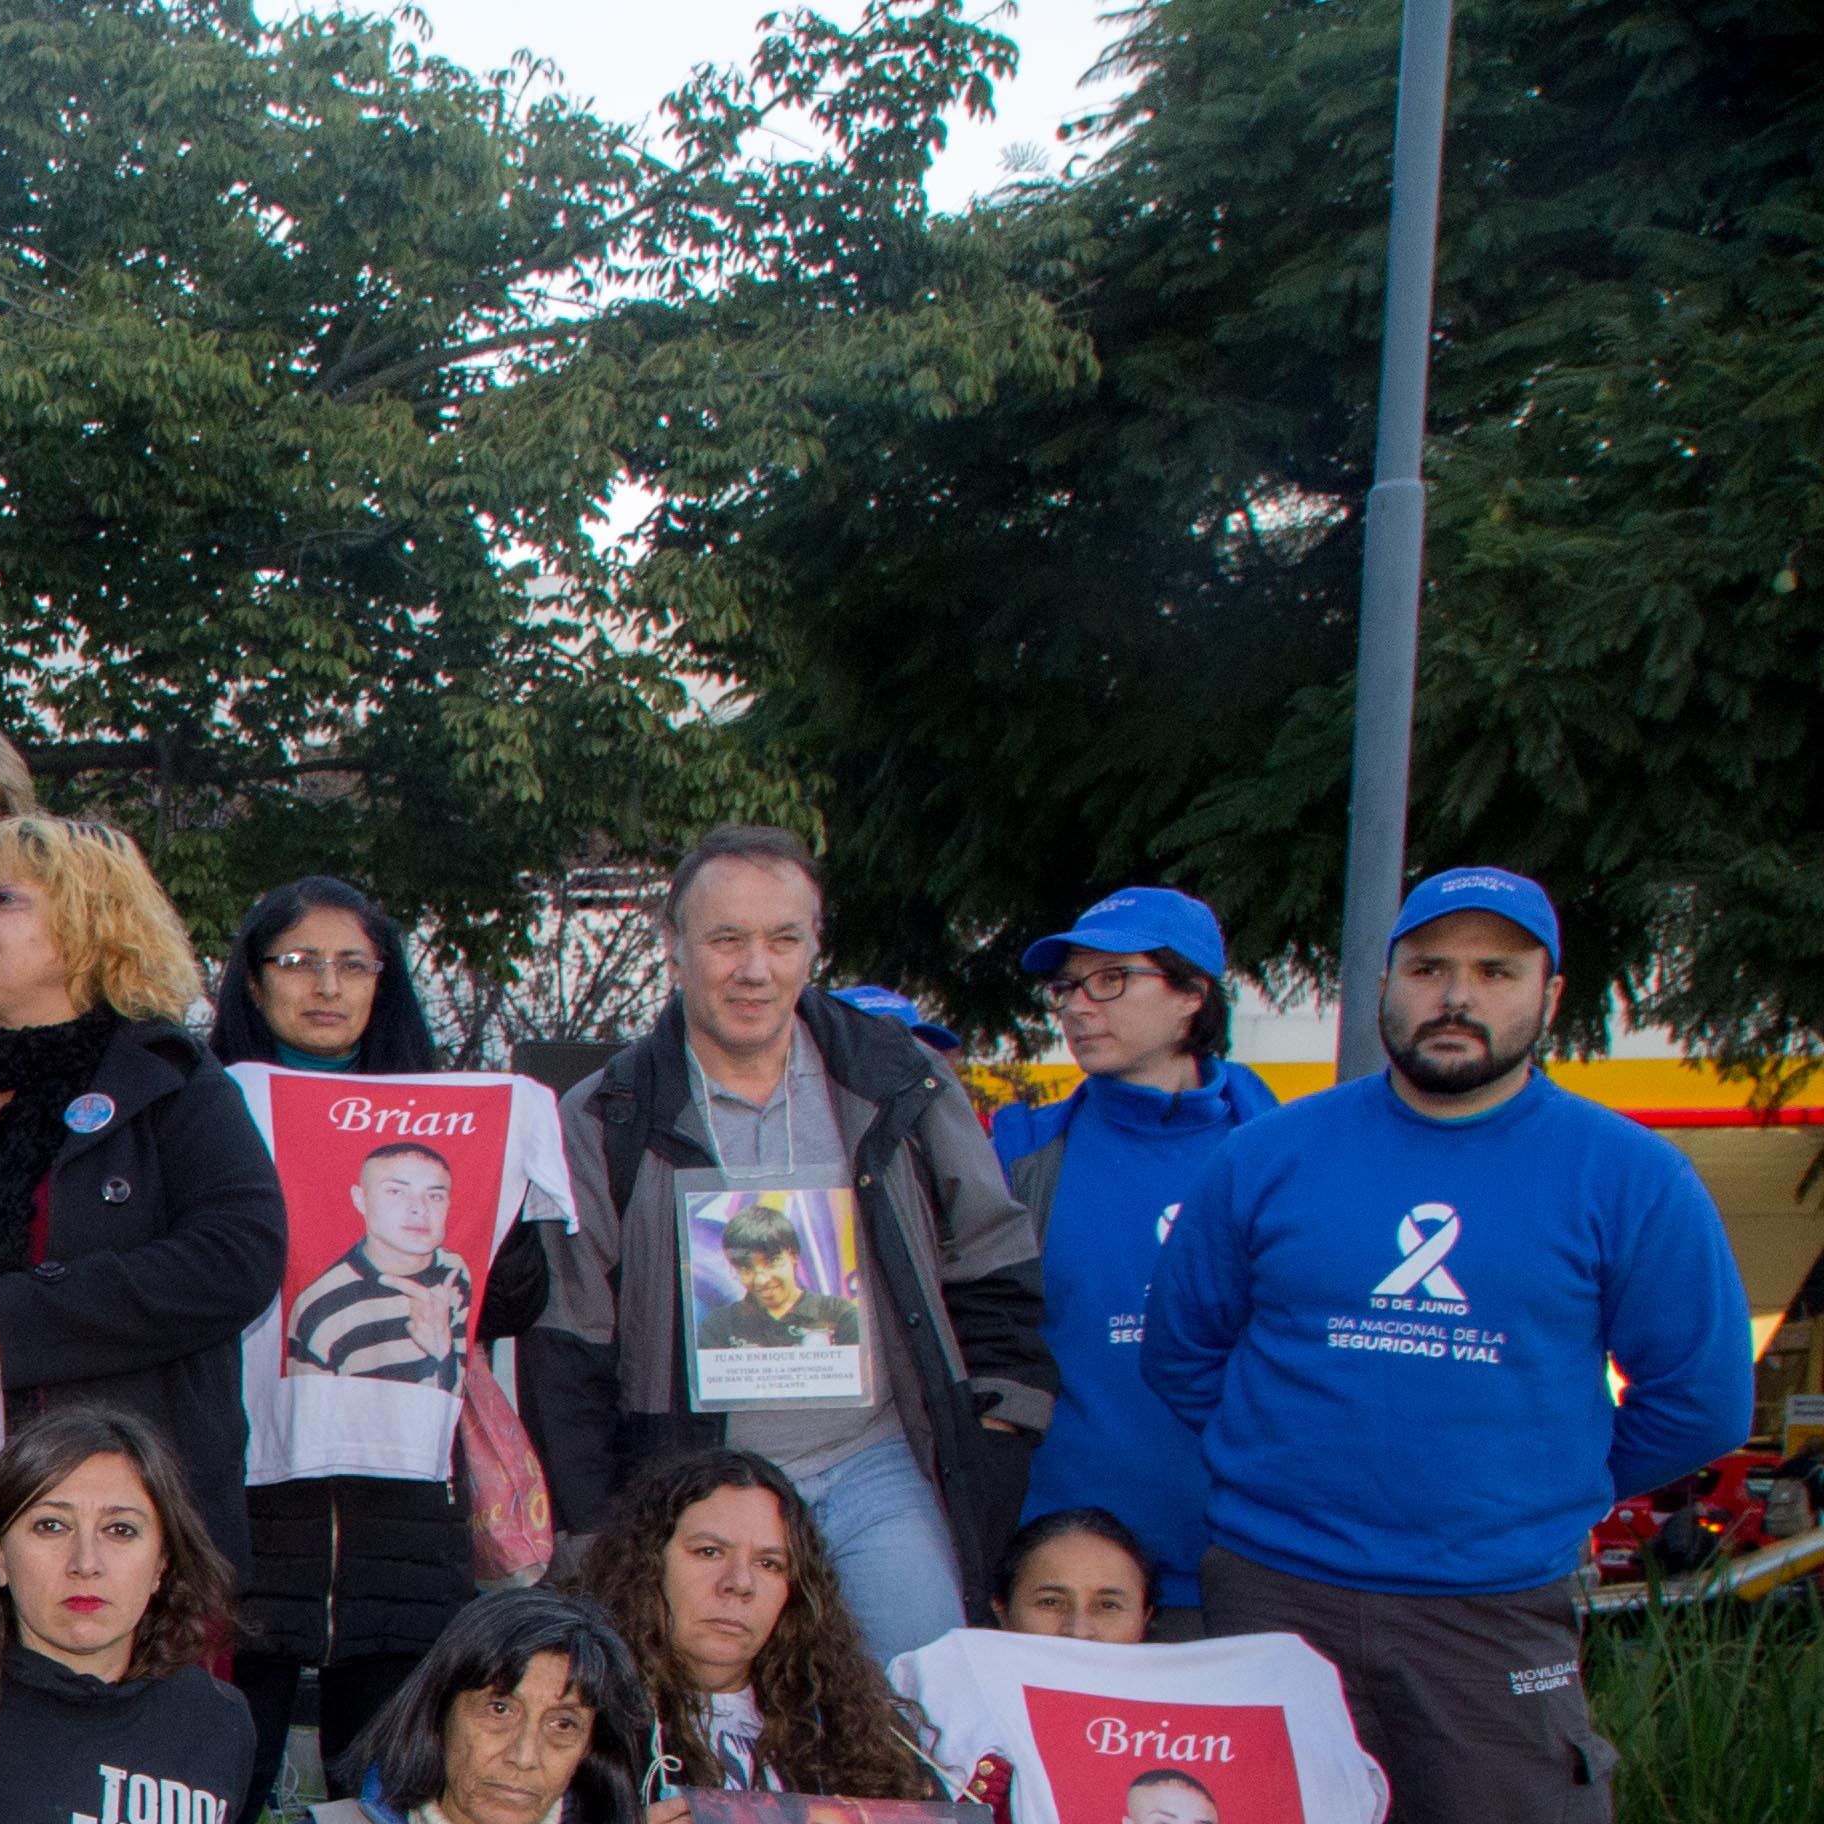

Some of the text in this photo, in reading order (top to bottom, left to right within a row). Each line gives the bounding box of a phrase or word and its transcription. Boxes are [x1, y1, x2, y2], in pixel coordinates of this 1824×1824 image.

[328, 1097, 477, 1136] Brian
[1109, 1312, 1136, 1327] DÍA
[1370, 1297, 1471, 1316] 10 DE JUNIO
[1327, 1316, 1507, 1344] DÍA NACIONAL DE LA
[1327, 1333, 1502, 1364] SEGURIDAD VIAL
[1086, 1716, 1235, 1763] Brian
